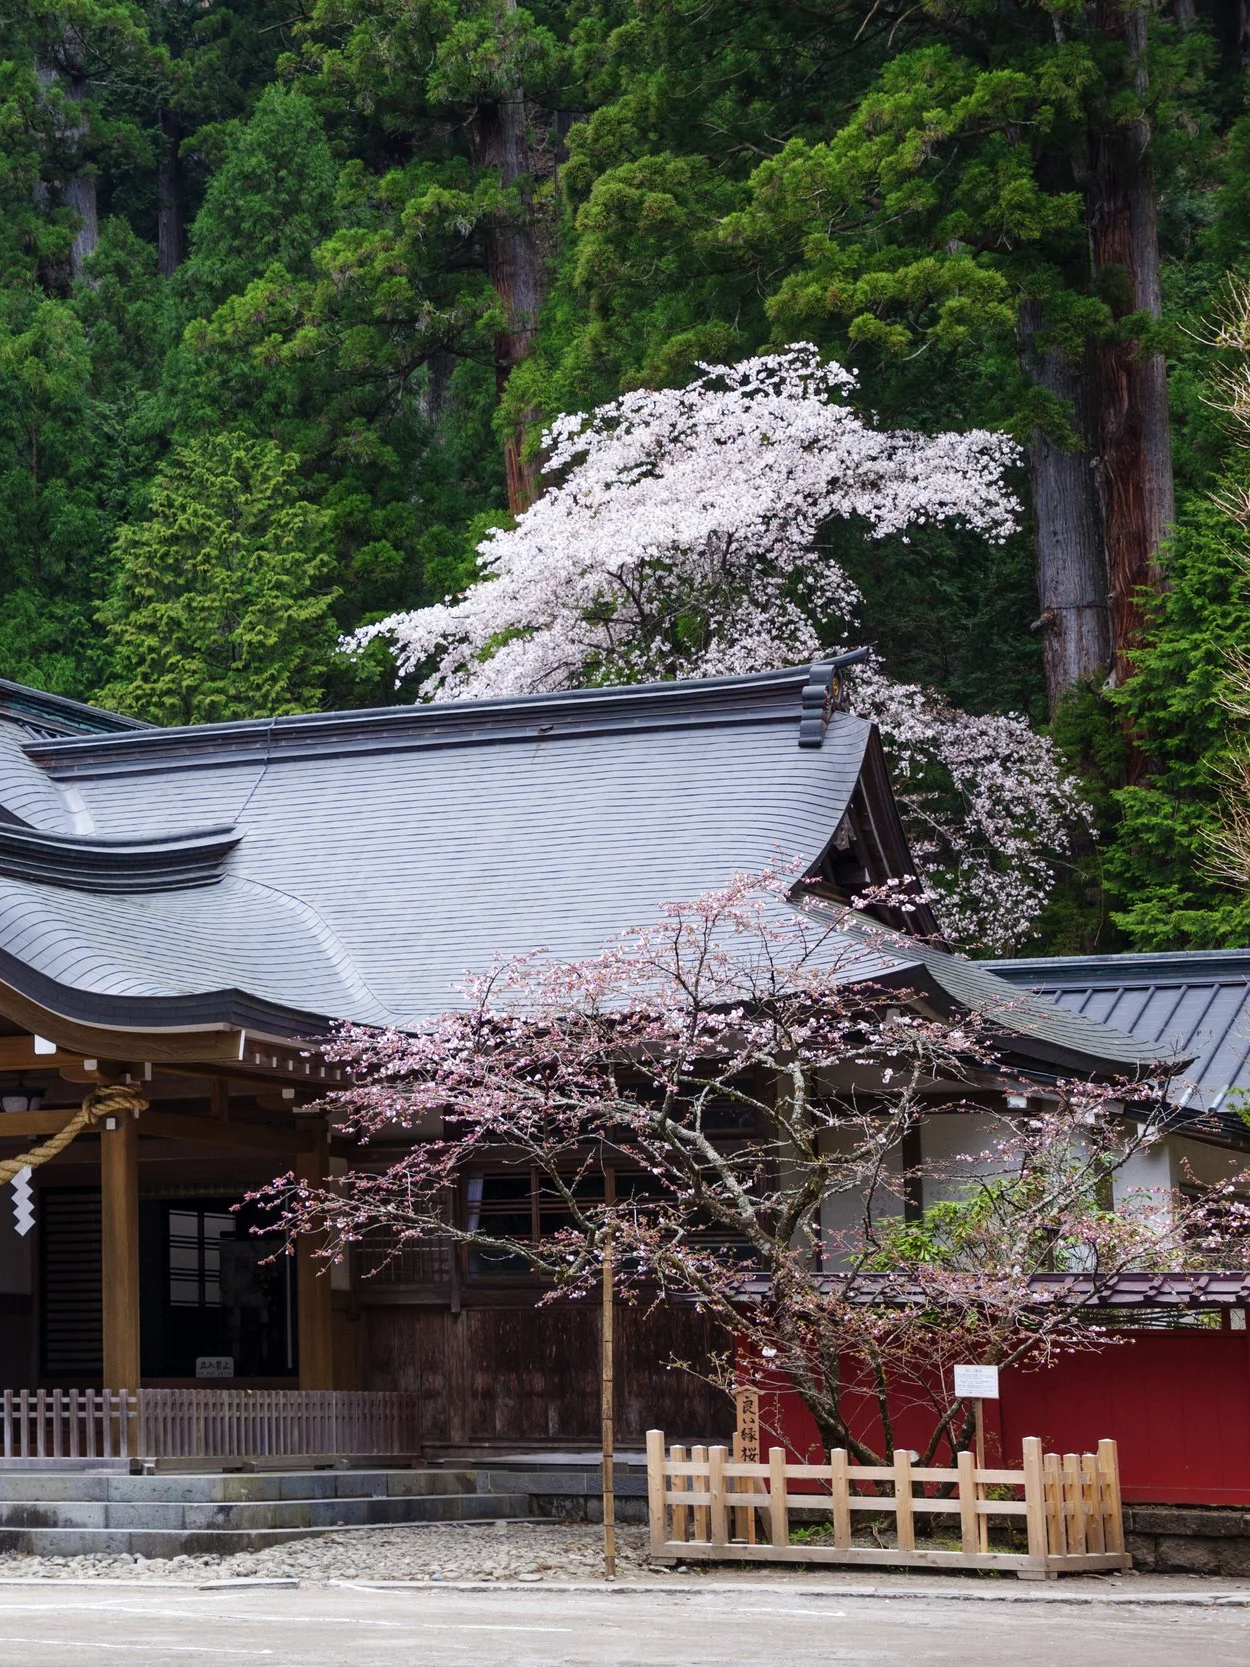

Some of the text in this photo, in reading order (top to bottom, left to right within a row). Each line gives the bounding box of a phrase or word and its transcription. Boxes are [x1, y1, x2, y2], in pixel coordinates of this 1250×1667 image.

[199, 1360, 231, 1370] 立入禁止
[740, 1395, 758, 1462] 良い縁桜
